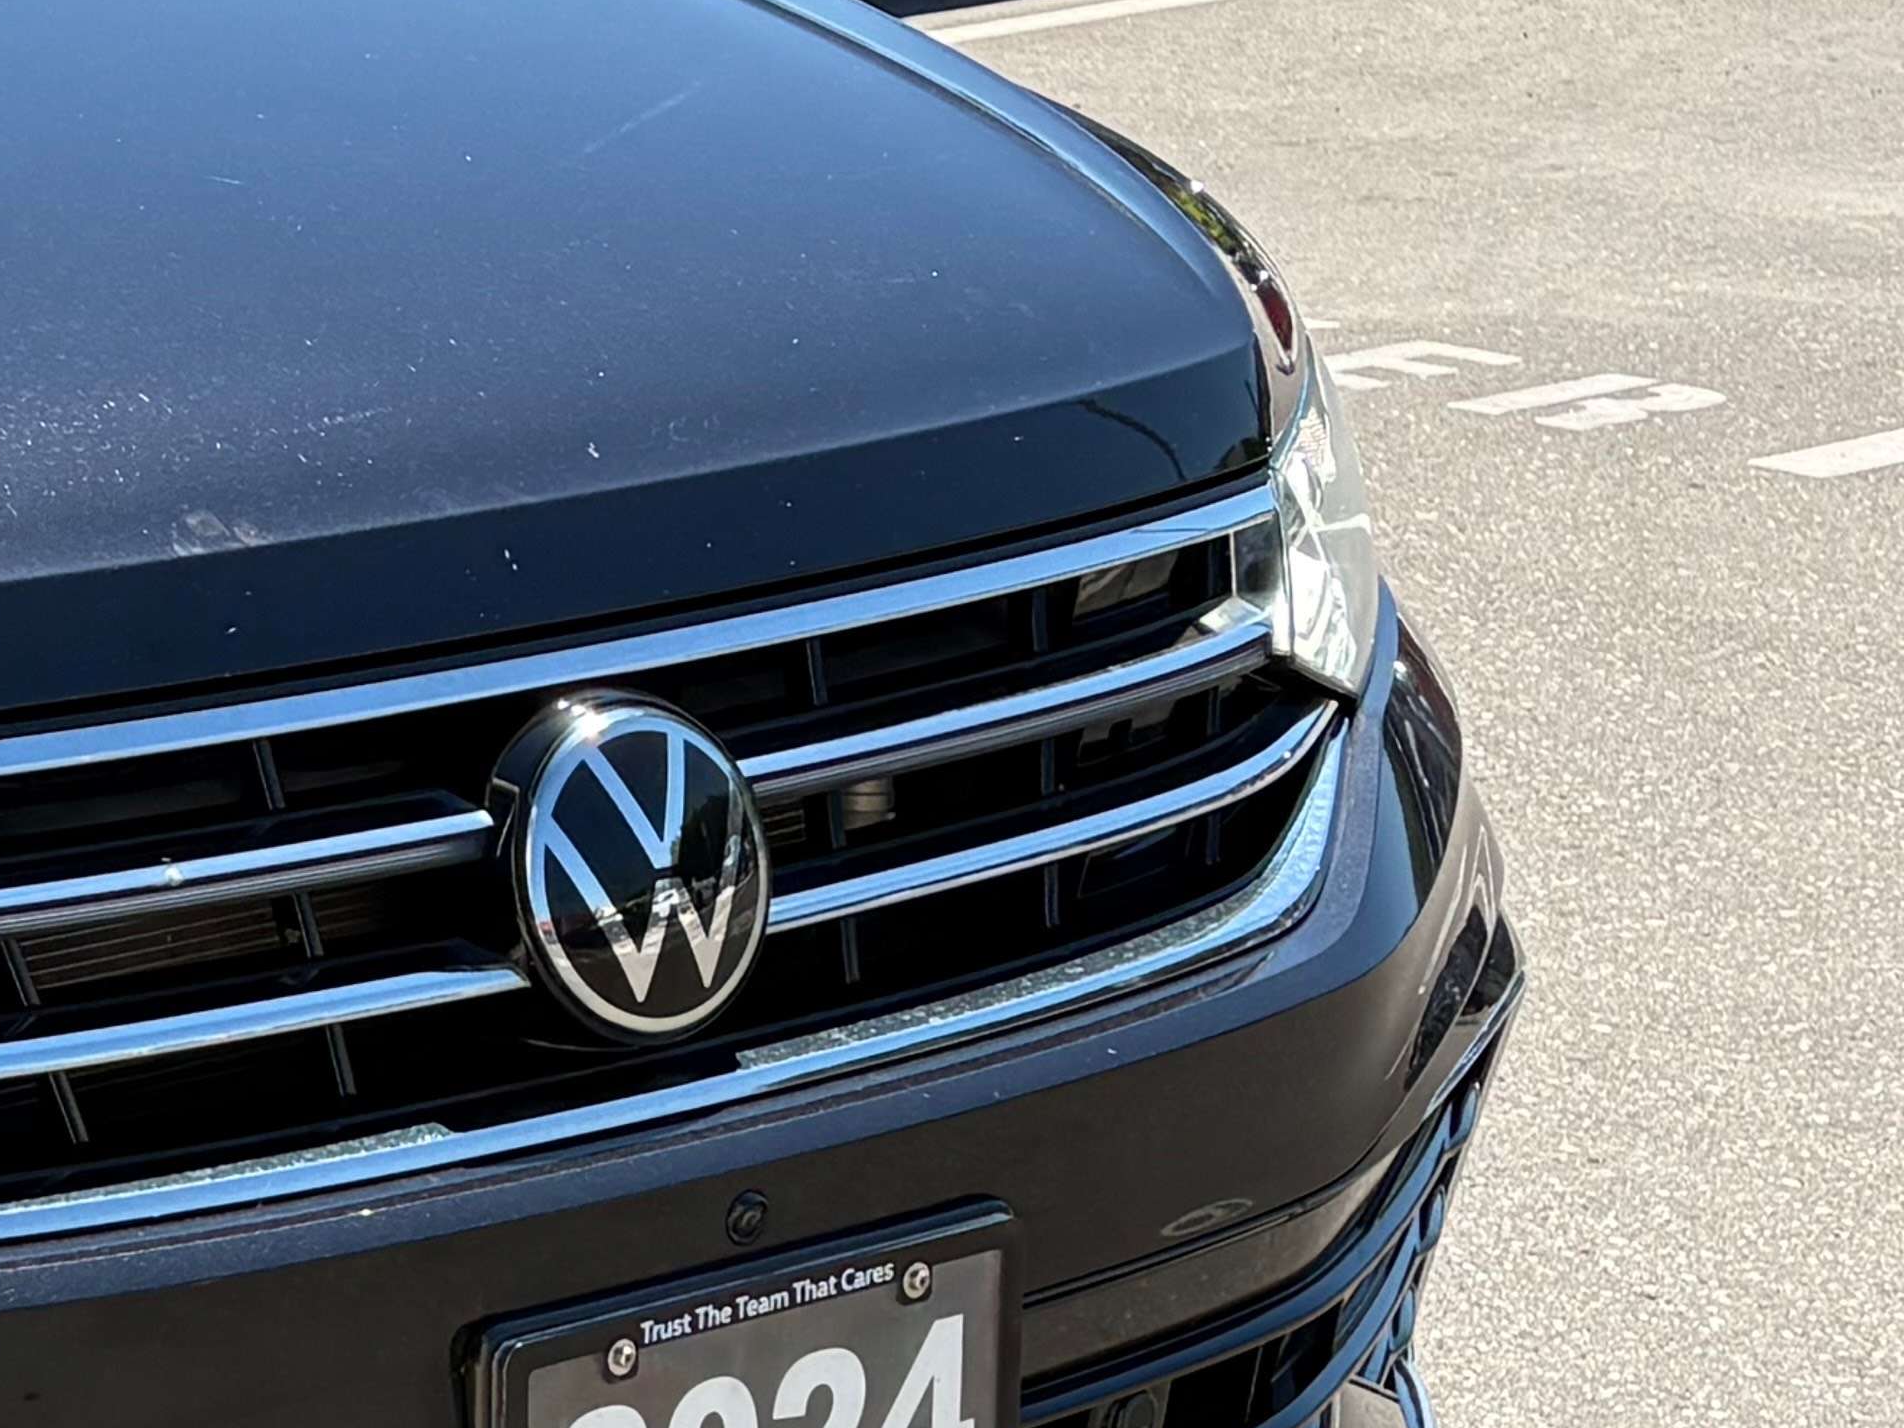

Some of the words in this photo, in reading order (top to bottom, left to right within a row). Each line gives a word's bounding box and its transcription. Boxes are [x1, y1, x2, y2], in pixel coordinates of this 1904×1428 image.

[641, 1313, 692, 1344] Trust
[695, 1303, 732, 1330] The
[736, 1293, 790, 1321] Team
[792, 1274, 838, 1303] That
[841, 1262, 895, 1292] Cares
